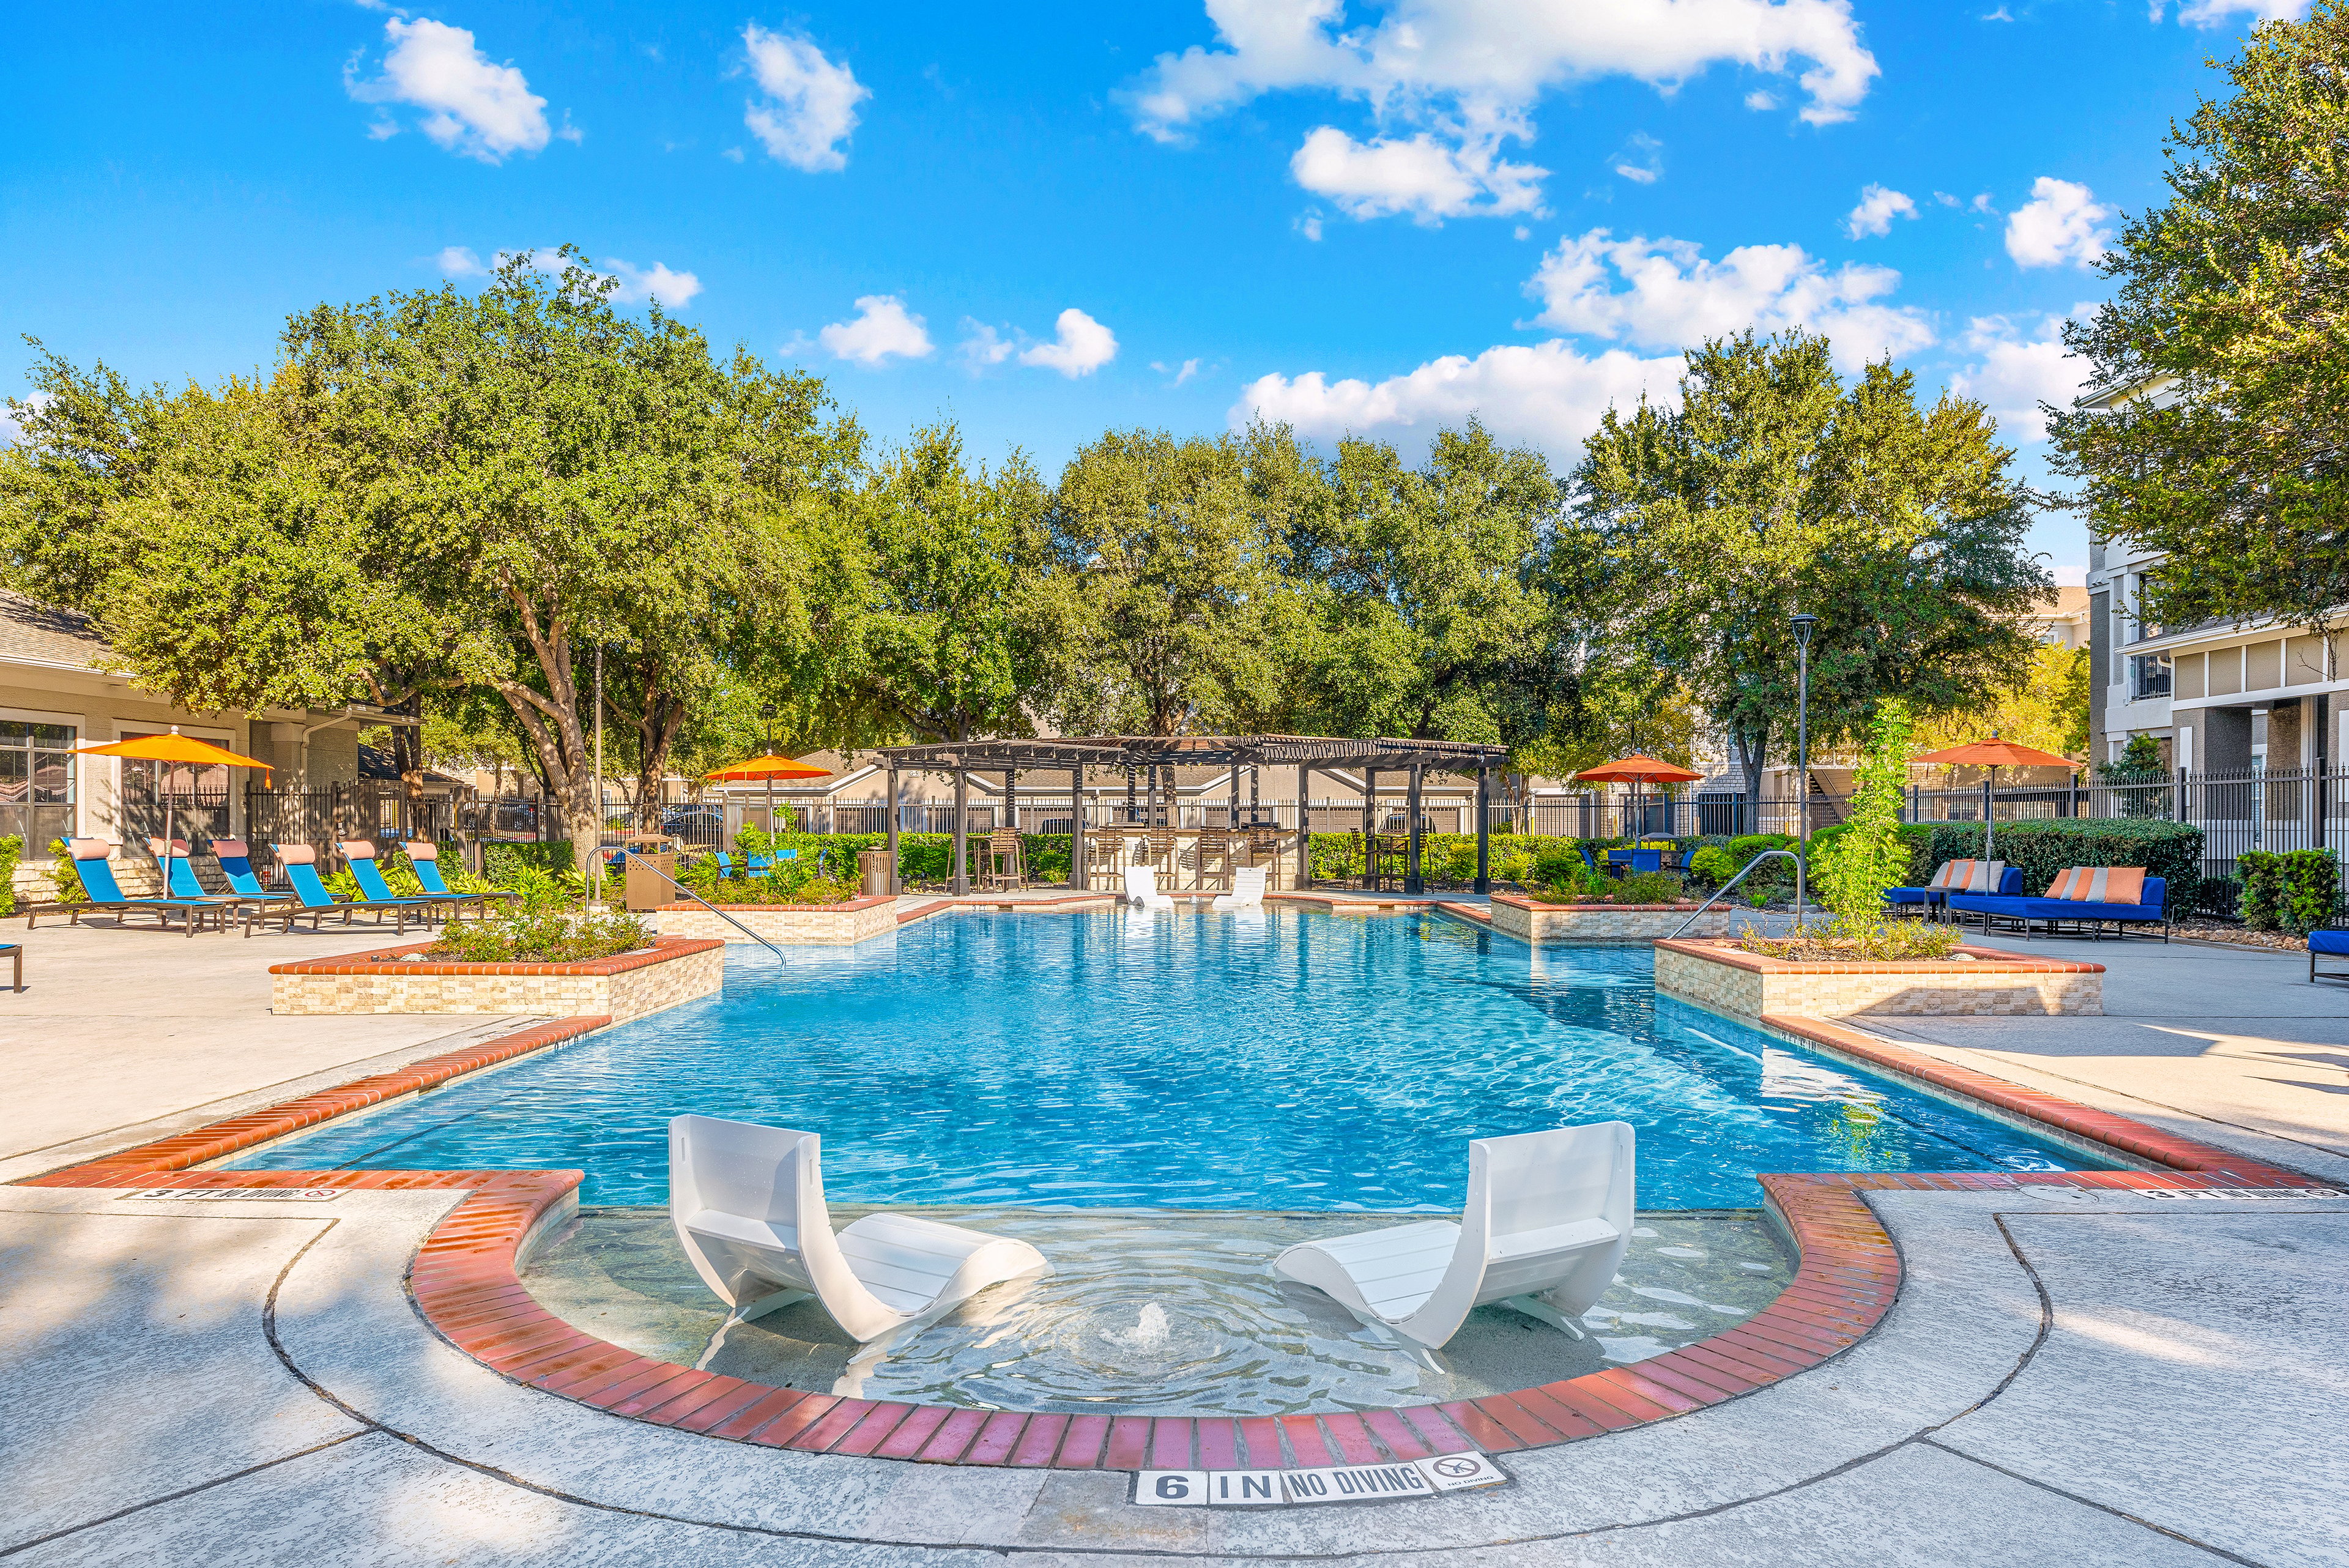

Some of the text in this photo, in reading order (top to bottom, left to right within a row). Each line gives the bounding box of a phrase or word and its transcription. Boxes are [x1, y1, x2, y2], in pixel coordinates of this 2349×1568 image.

[214, 1189, 248, 1198] NO
[240, 1189, 301, 1198] DIVING
[2178, 1190, 2222, 1198] FT
[1156, 1467, 1425, 1499] 6 IN NO DIVING
[1463, 1475, 1494, 1484] DIVING
